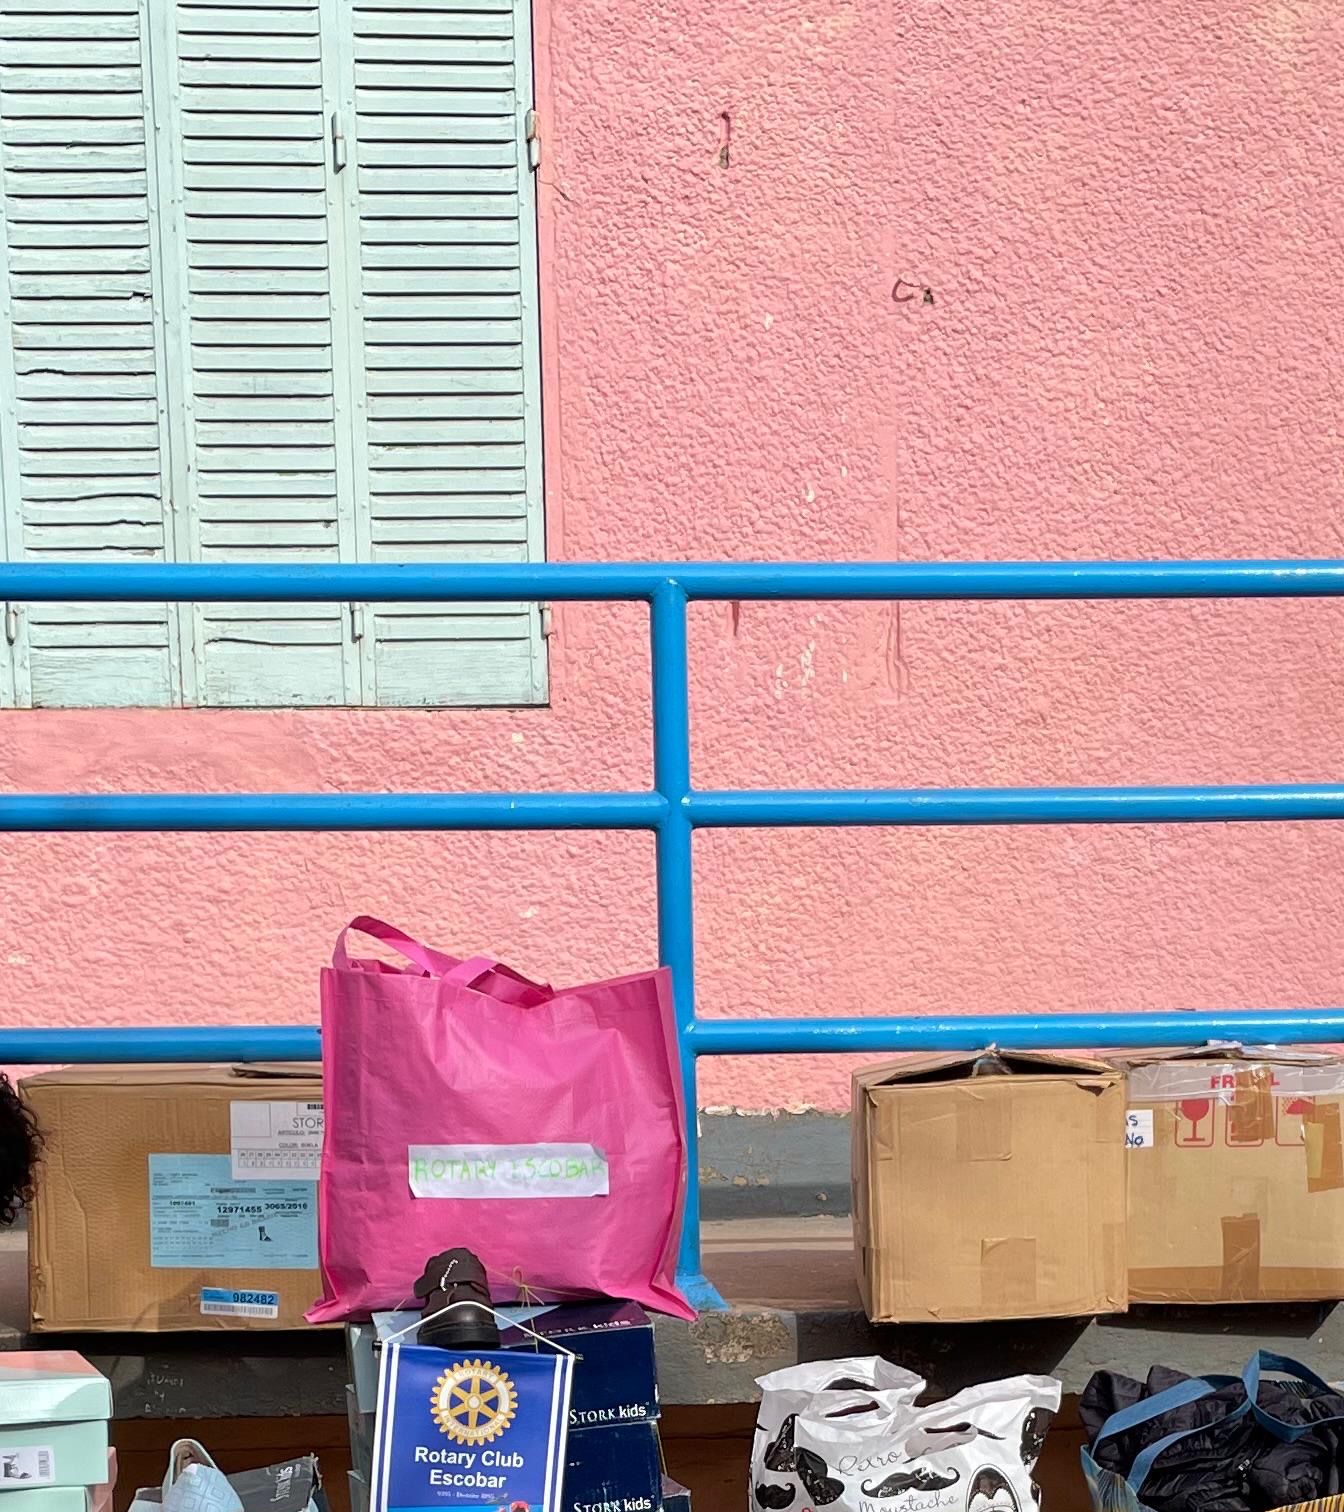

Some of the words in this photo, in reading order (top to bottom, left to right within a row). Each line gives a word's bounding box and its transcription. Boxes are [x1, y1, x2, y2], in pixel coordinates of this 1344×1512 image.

[414, 1157, 496, 1182] ROTARY
[232, 1293, 274, 1305] 982482
[619, 1402, 647, 1418] kids
[415, 1446, 476, 1469] Rotary
[481, 1450, 524, 1468] Club
[430, 1469, 507, 1488] Escobar
[624, 1498, 652, 1512] kids
